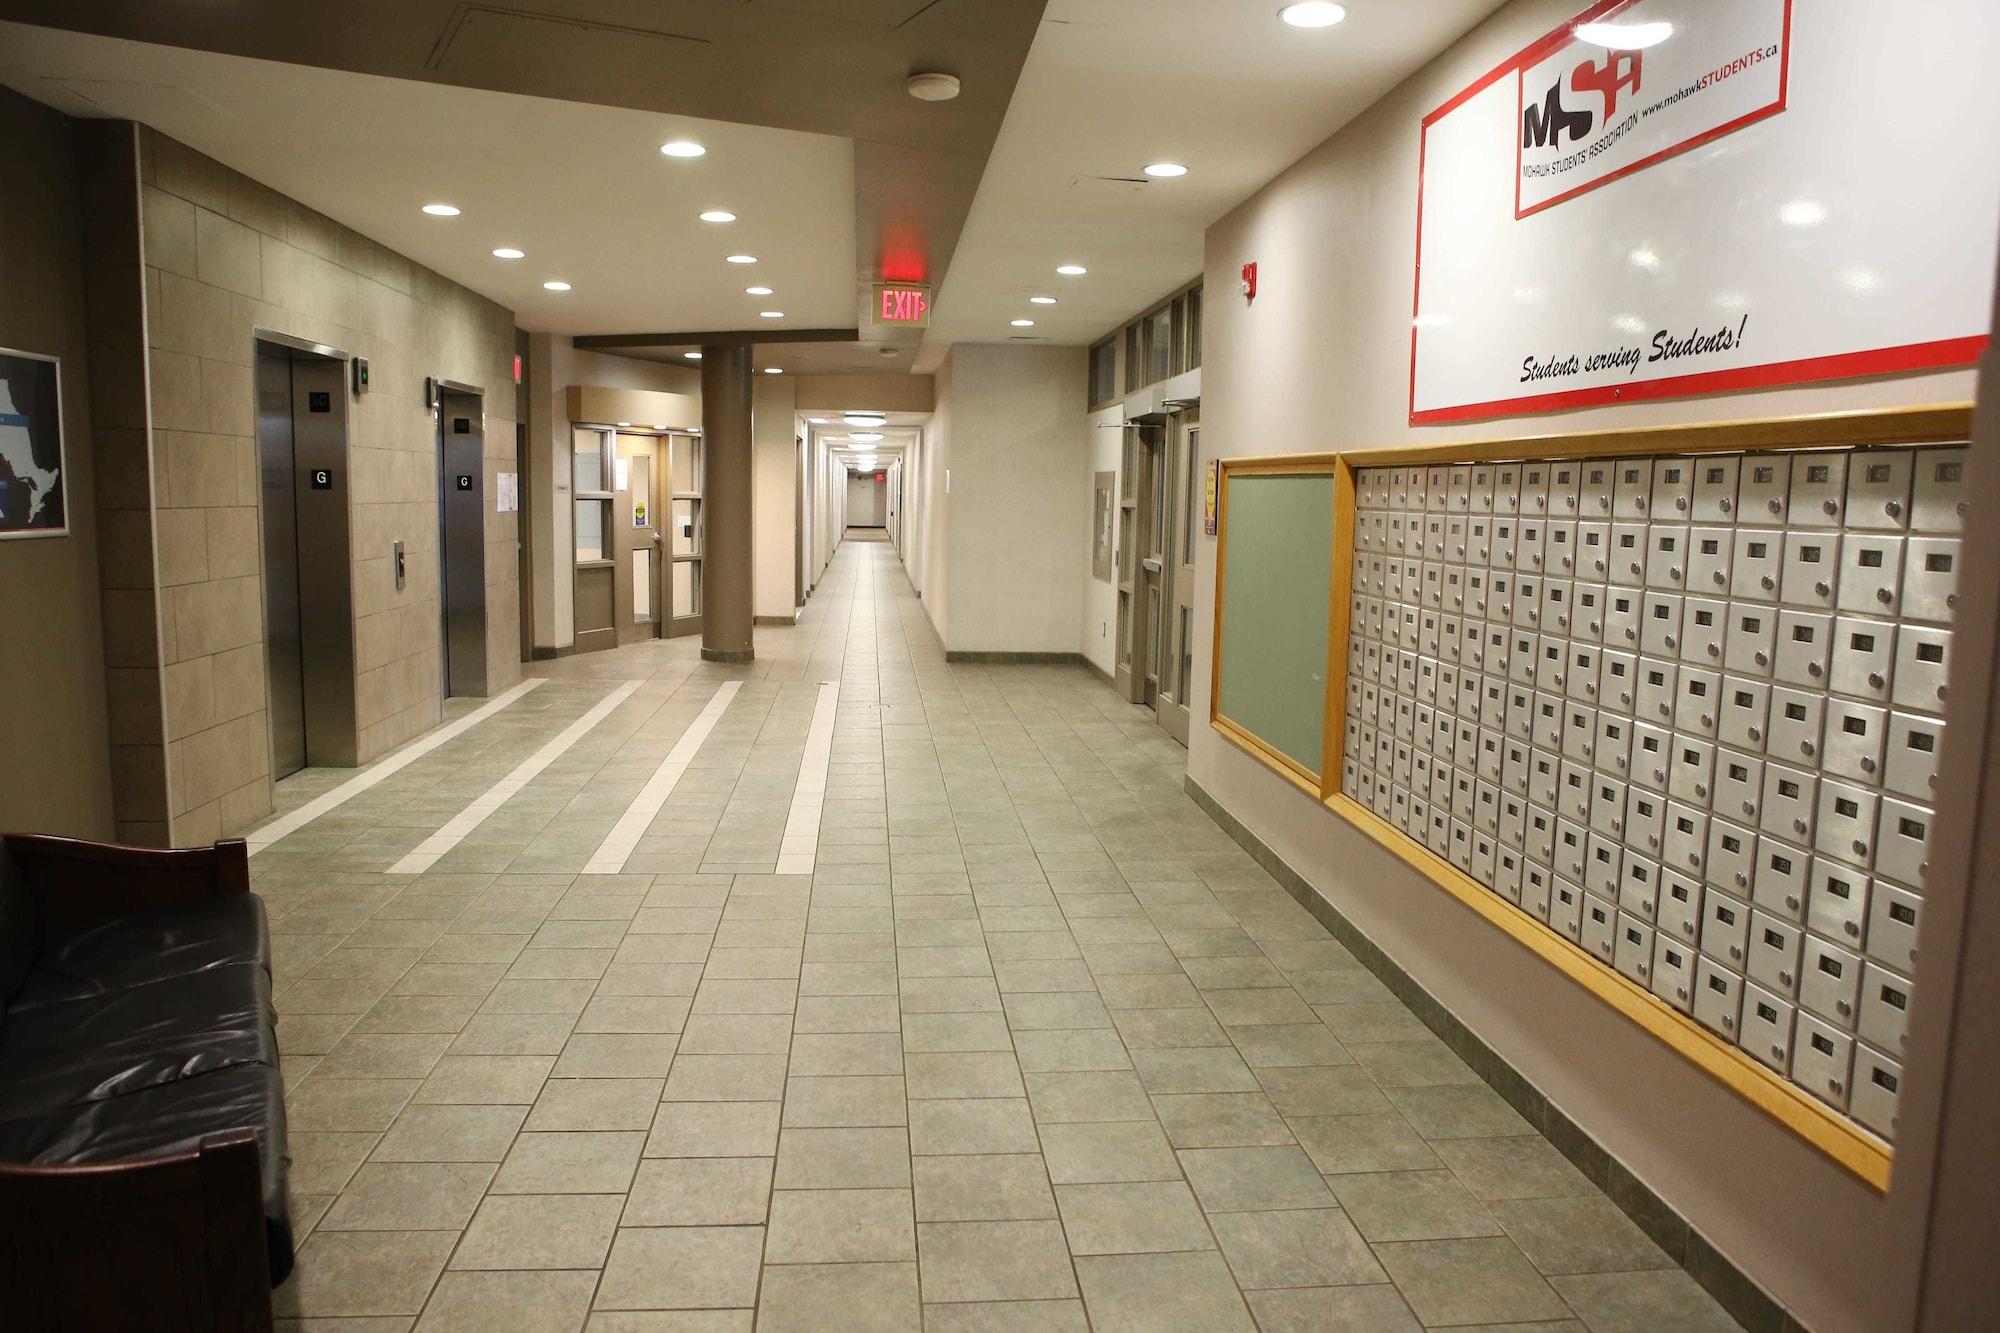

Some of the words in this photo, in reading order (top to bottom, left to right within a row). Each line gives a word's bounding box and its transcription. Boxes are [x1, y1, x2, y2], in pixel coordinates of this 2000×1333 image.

[1523, 162, 1550, 178] MOHAWK
[1589, 110, 1639, 158] ASSOCIATION
[1641, 44, 1778, 118] www.mohawkSTUDENTS.ca
[882, 290, 923, 321] EXIT
[1520, 355, 1580, 382] Students
[1584, 347, 1641, 375] serving
[1648, 314, 1748, 362] Students!
[316, 472, 327, 484] G
[461, 477, 469, 487] G
